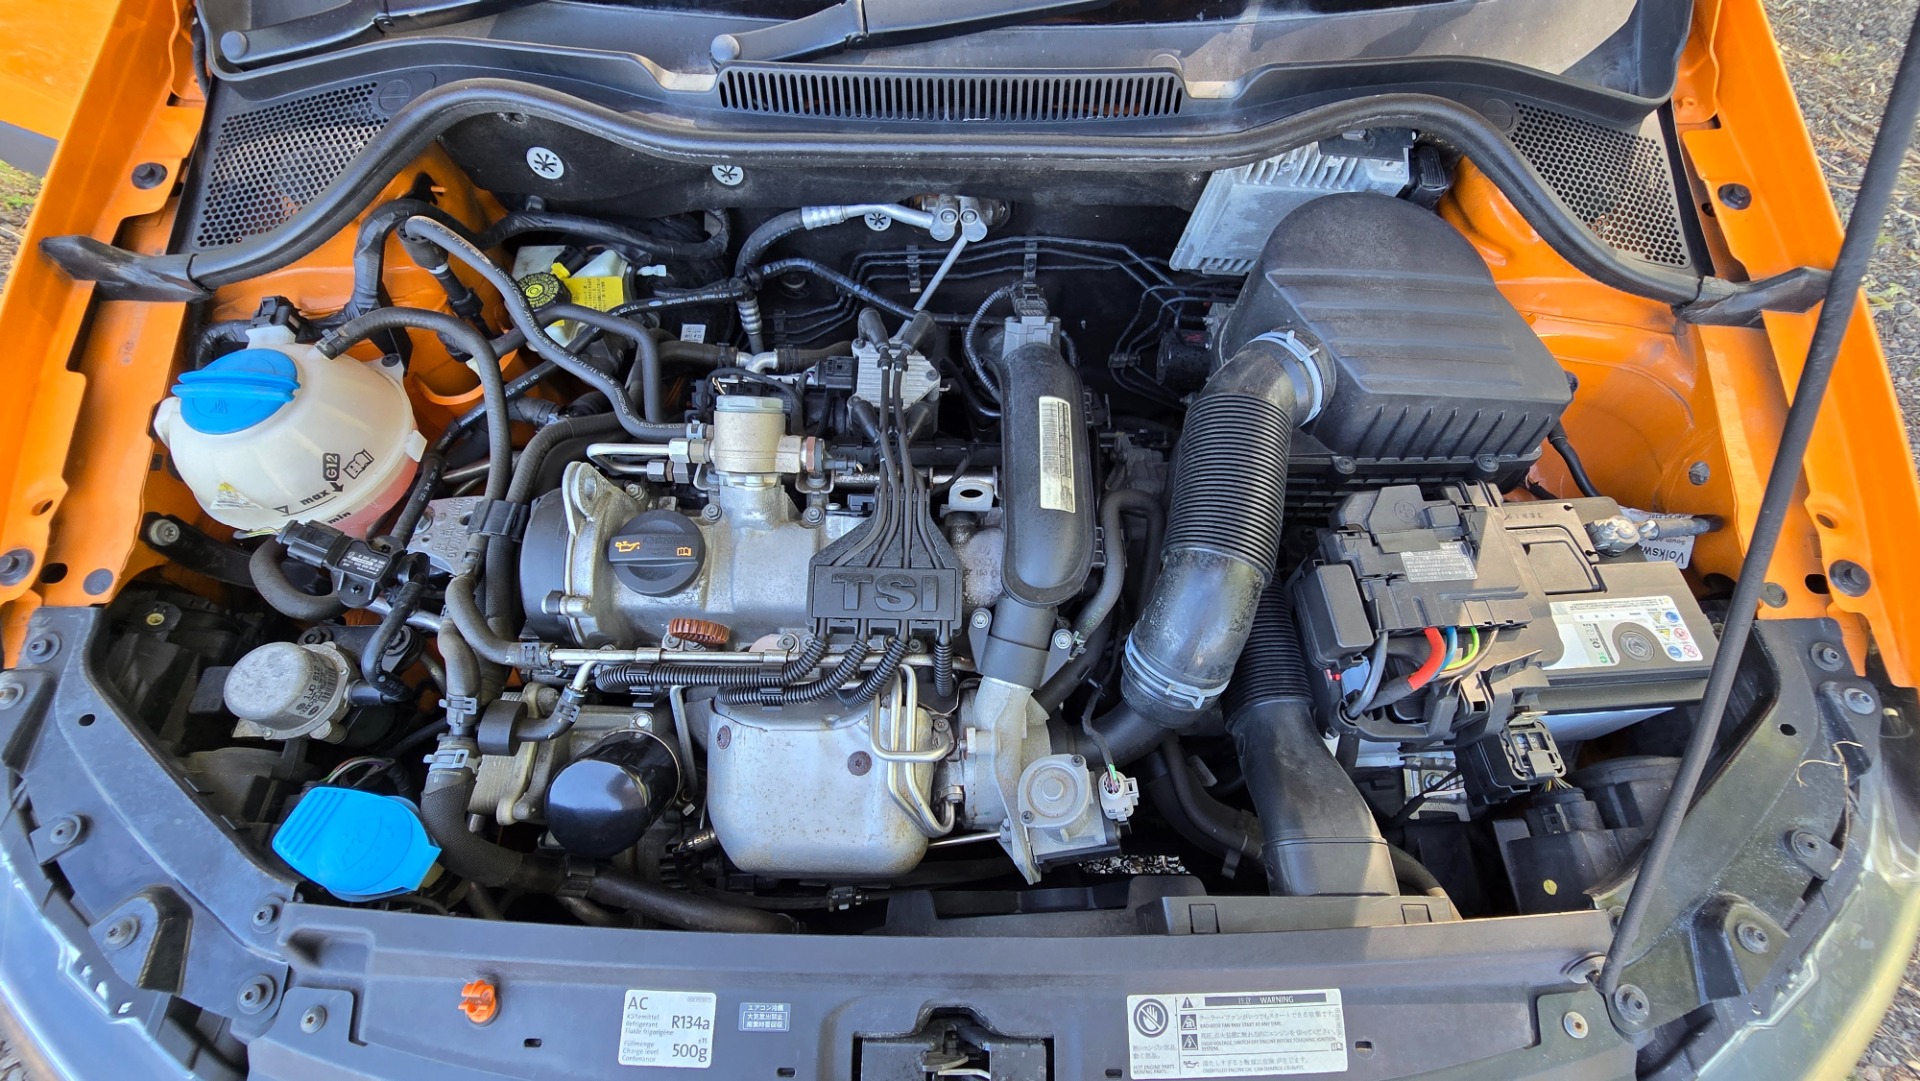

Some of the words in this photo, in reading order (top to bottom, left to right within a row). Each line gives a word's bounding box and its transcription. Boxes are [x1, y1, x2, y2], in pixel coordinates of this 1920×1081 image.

[325, 455, 338, 478] G12
[300, 490, 330, 506] max
[327, 512, 352, 524] min
[832, 573, 939, 612] TSI
[627, 996, 649, 1010] AC
[1259, 995, 1294, 1005] WARNING
[625, 1021, 658, 1029] Refrigerant
[671, 1015, 710, 1031] R134a
[622, 1048, 643, 1056] Charge
[671, 1043, 708, 1062] 500g
